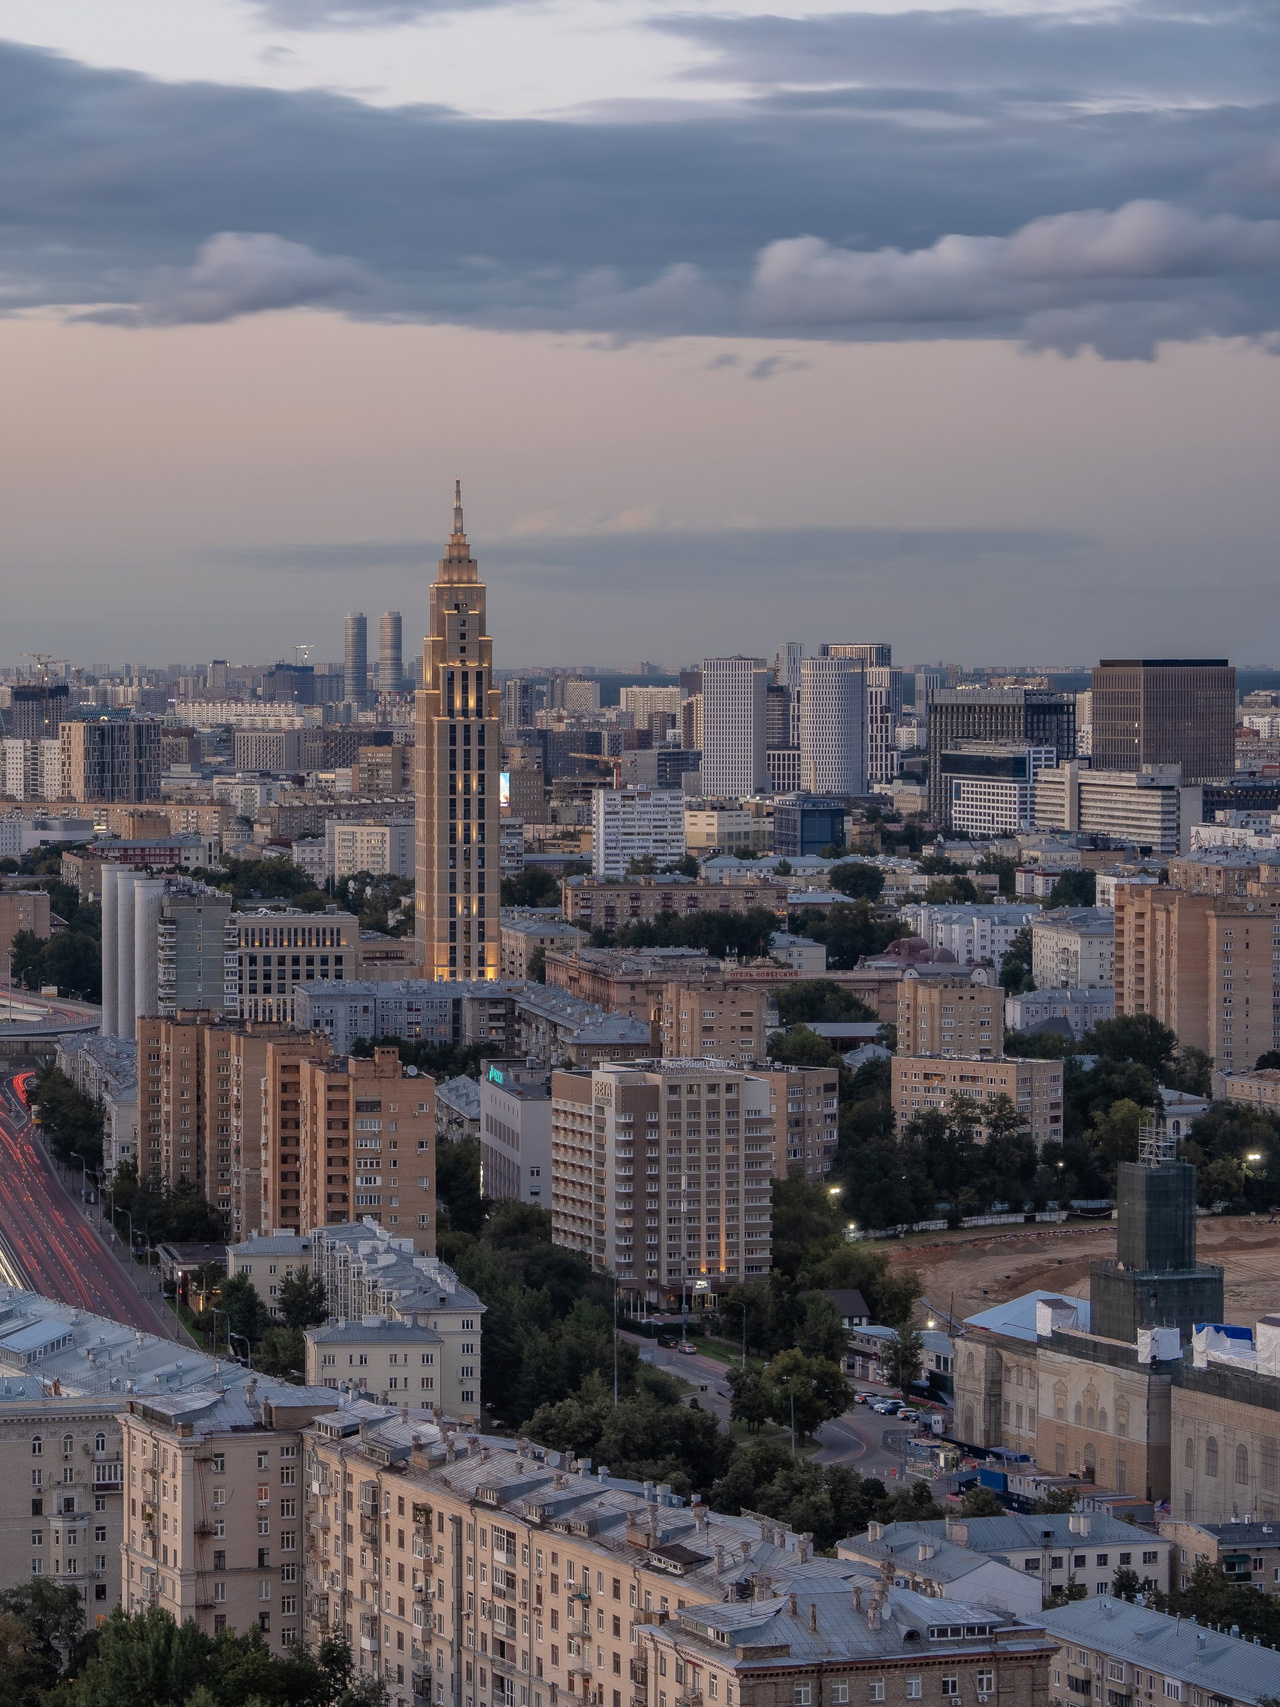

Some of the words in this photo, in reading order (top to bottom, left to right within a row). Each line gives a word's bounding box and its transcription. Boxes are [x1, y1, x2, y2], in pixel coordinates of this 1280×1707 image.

[756, 970, 799, 978] СОВЕТСКИЙ
[664, 1060, 715, 1069] ГОСТИНИЦА
[716, 1060, 735, 1068] БЕГА
[595, 1081, 612, 1098] БЕГА
